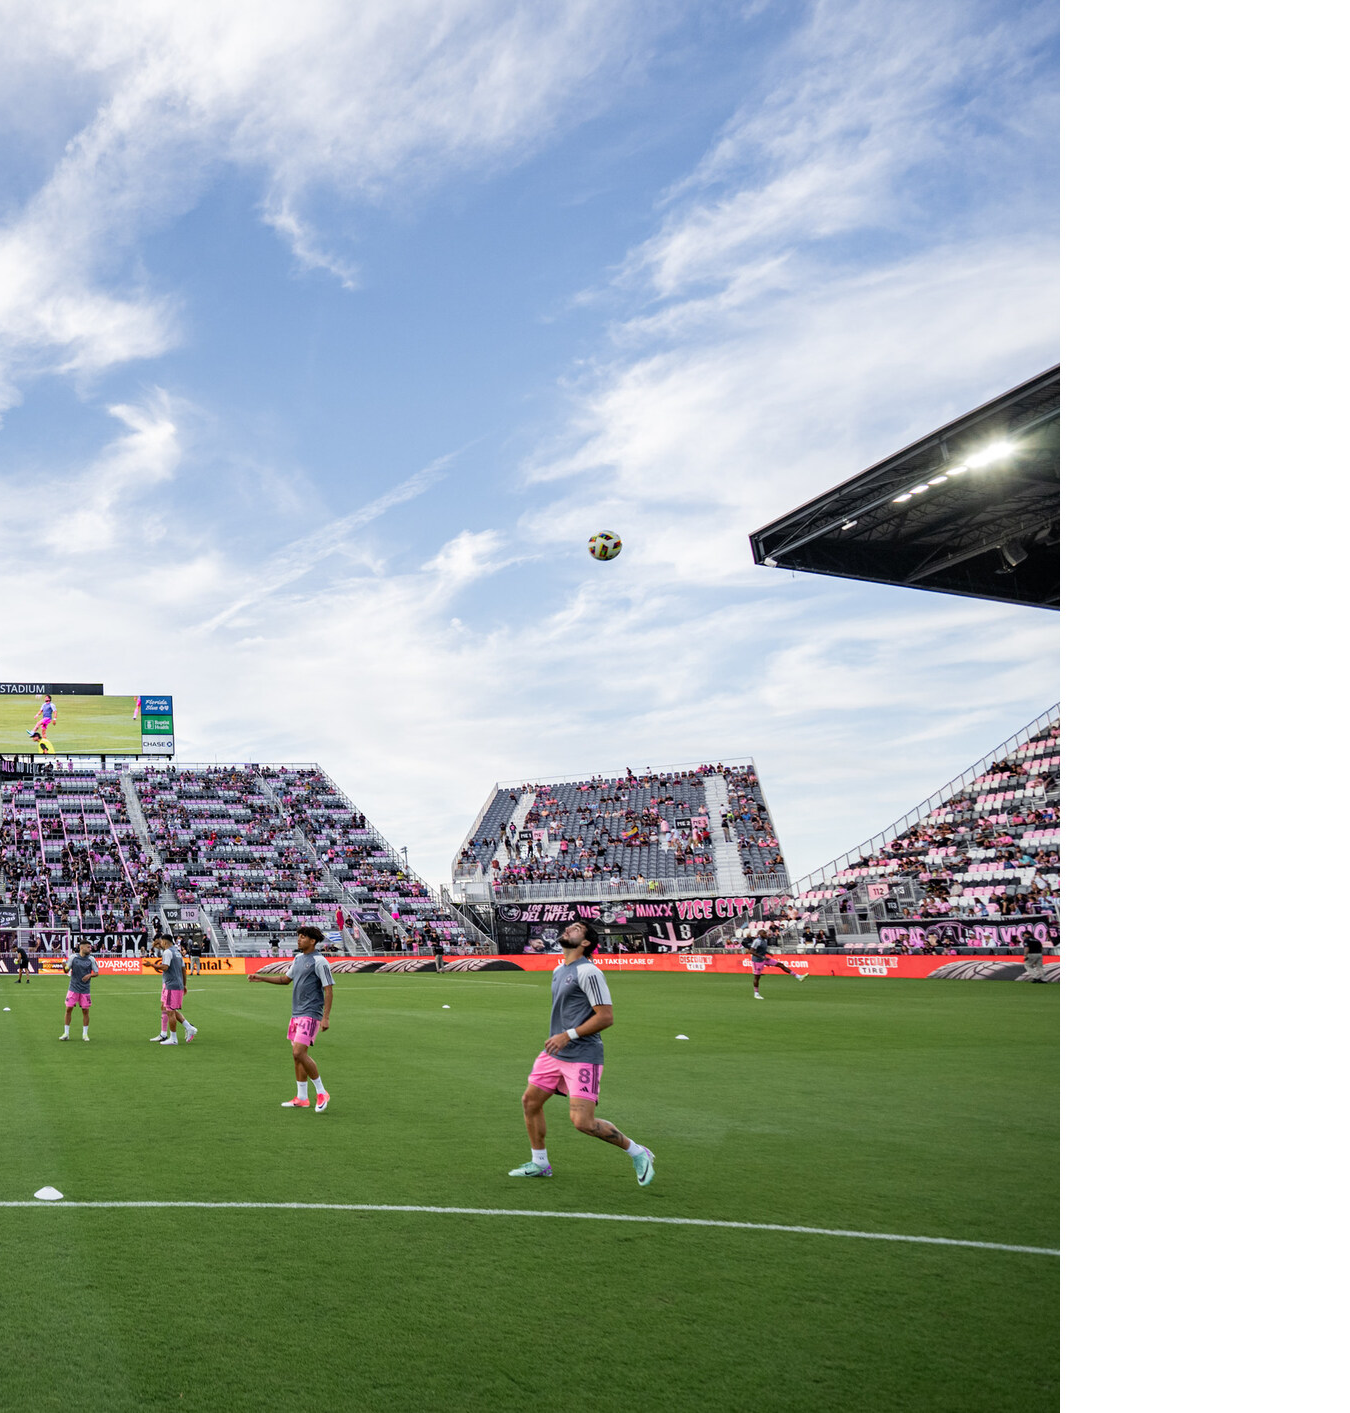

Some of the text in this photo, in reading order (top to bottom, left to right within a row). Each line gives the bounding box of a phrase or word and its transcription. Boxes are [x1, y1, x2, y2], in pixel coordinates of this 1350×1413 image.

[0, 684, 46, 694] STADIUM
[2, 760, 15, 773] MLS
[872, 888, 885, 896] 112
[527, 904, 570, 912] LOS PIBES
[635, 903, 674, 917] MMXX
[675, 898, 714, 920] VICE
[715, 897, 756, 918] CITY
[520, 911, 576, 922] DEL INTER
[104, 934, 143, 955] CITY
[97, 960, 140, 968] DYARMOR
[847, 957, 898, 967] DISCOUNT
[578, 1068, 591, 1084] 8
